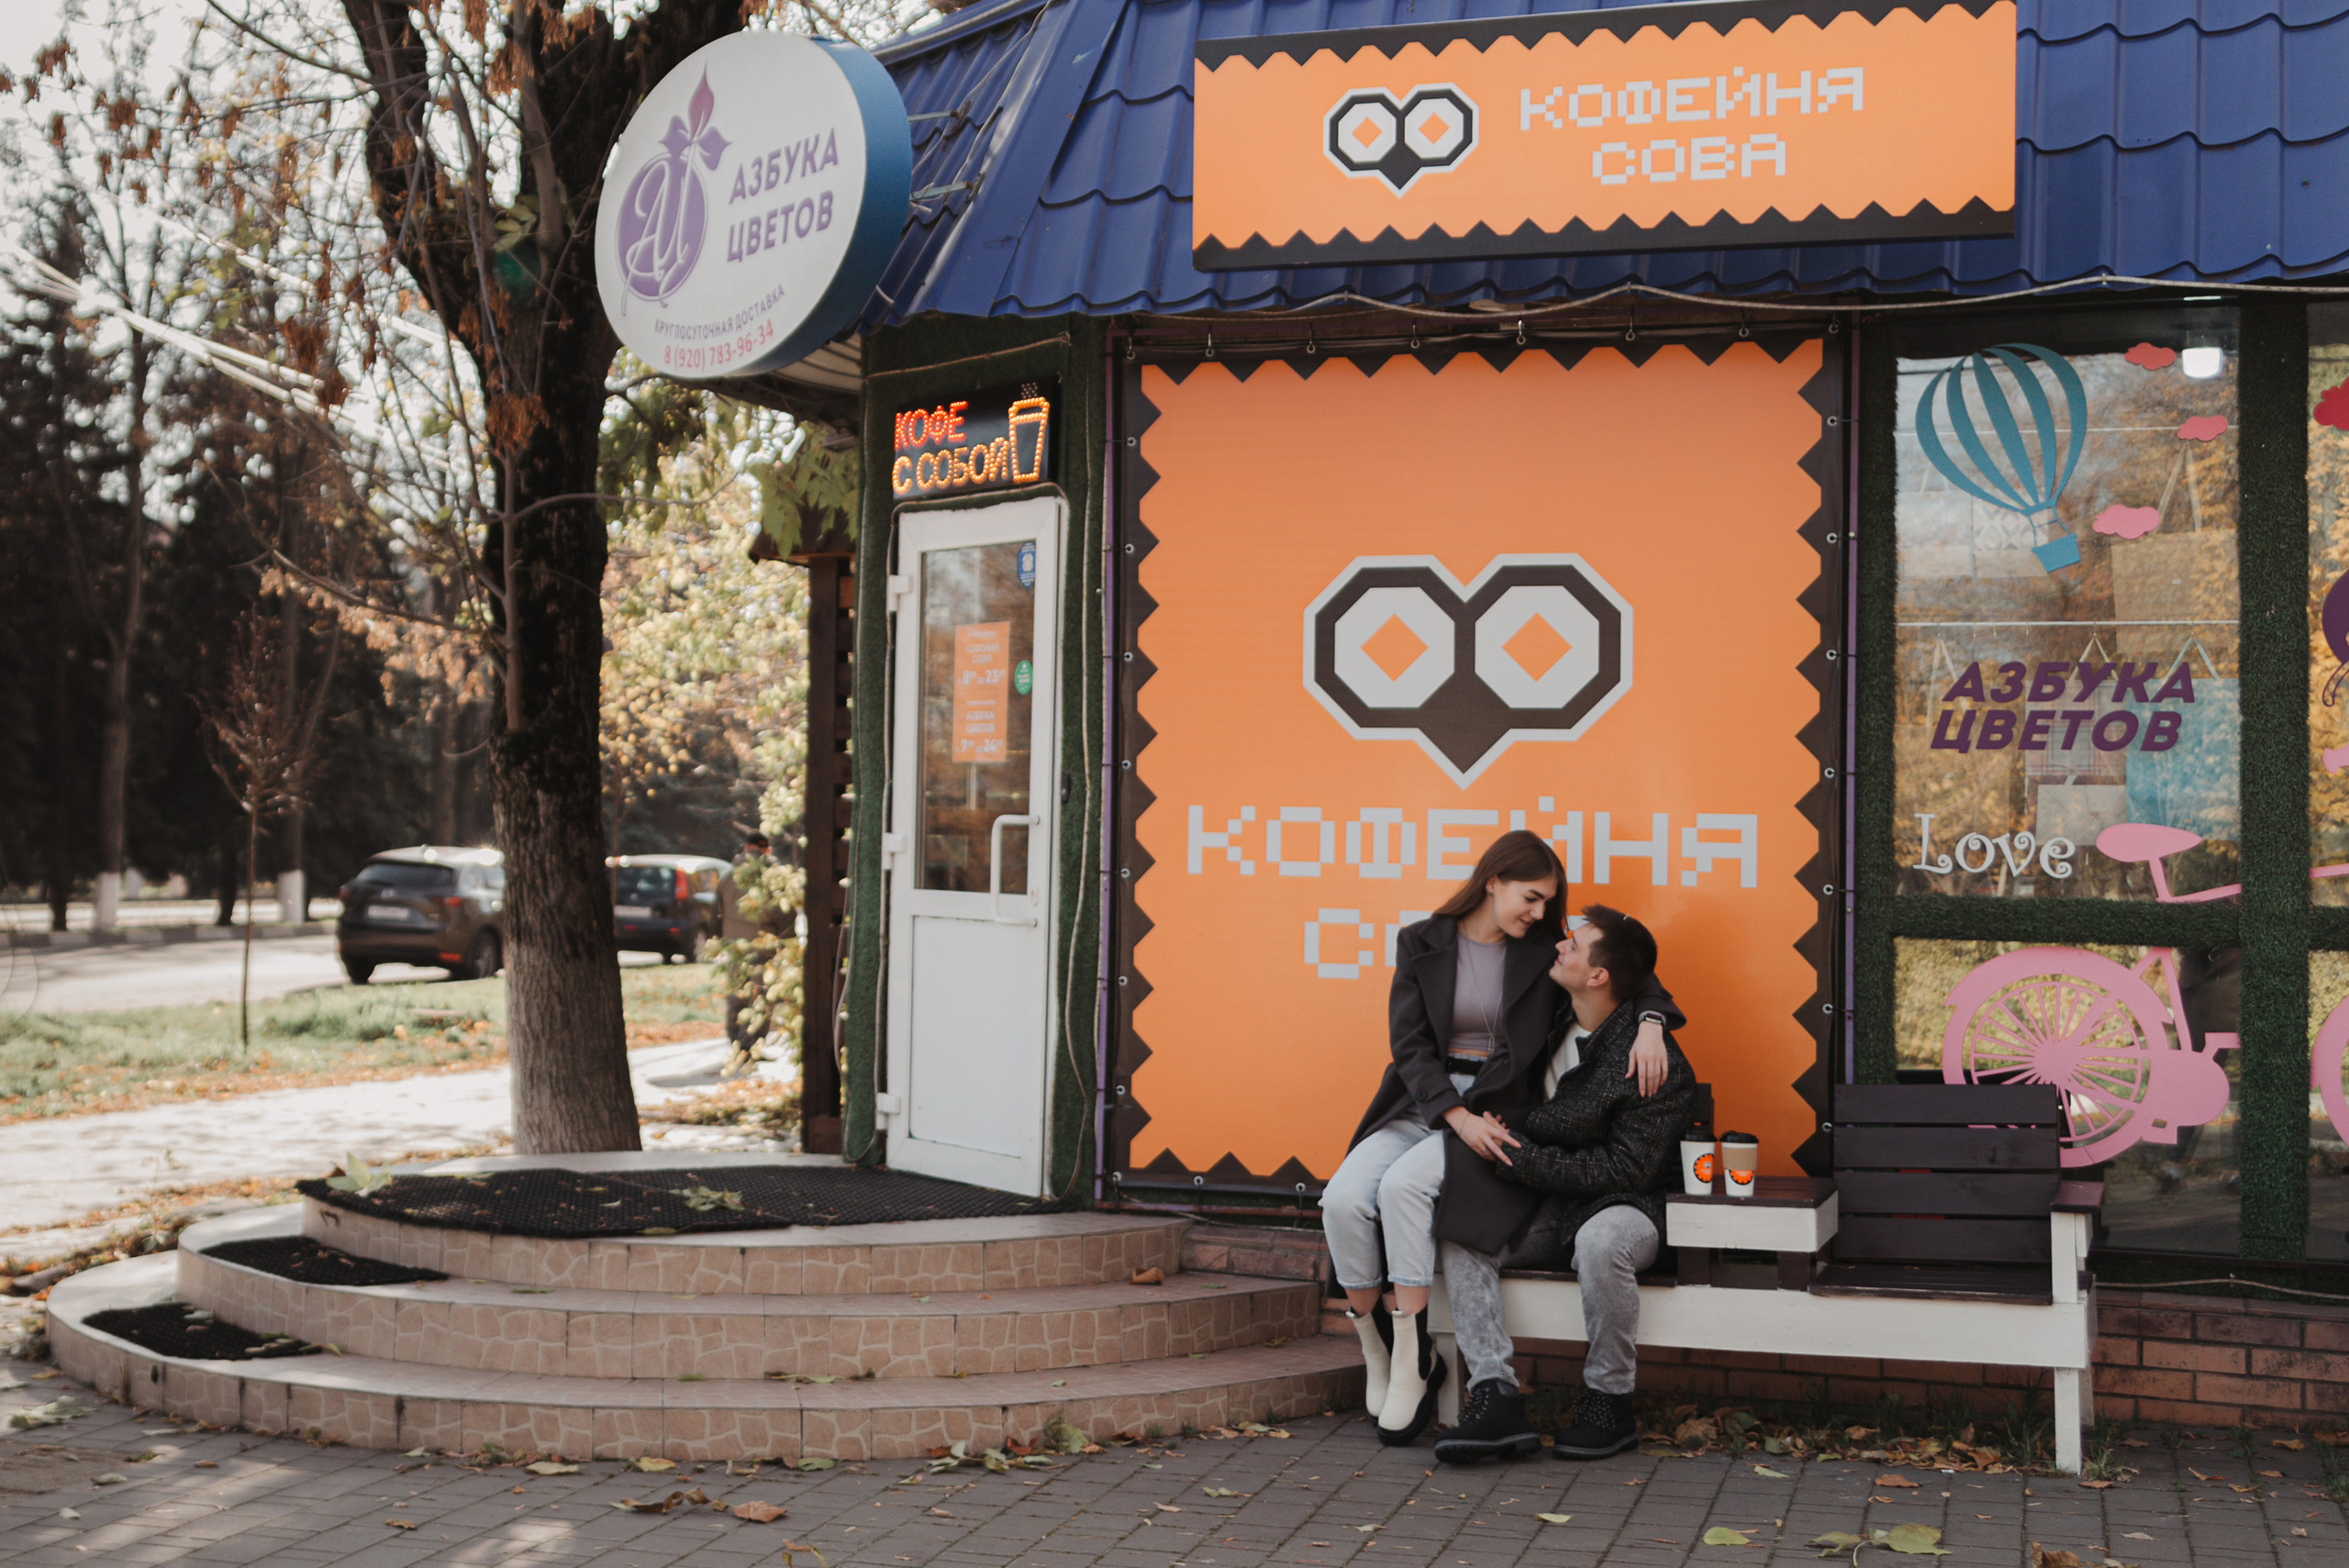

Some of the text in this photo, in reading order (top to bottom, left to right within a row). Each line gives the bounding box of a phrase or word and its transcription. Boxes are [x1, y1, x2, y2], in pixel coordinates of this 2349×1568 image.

[1520, 66, 1864, 131] КОФЕЙНЯ
[729, 128, 839, 205] АЗБУКА
[1592, 133, 1787, 185] СОВА
[727, 190, 834, 263] ЦВЕТОВ
[654, 284, 785, 339] КРУГЛОСУТОЧНАЯ ДОСТАВКА
[664, 318, 774, 372] 8 (920) 783-96-34
[894, 400, 968, 451] КОФЕ
[892, 437, 1009, 495] С СОБОЙ
[1942, 662, 2196, 703] АЗБУКА
[1931, 709, 2183, 753] ЦВЕТОВ
[1912, 812, 2076, 879] Love
